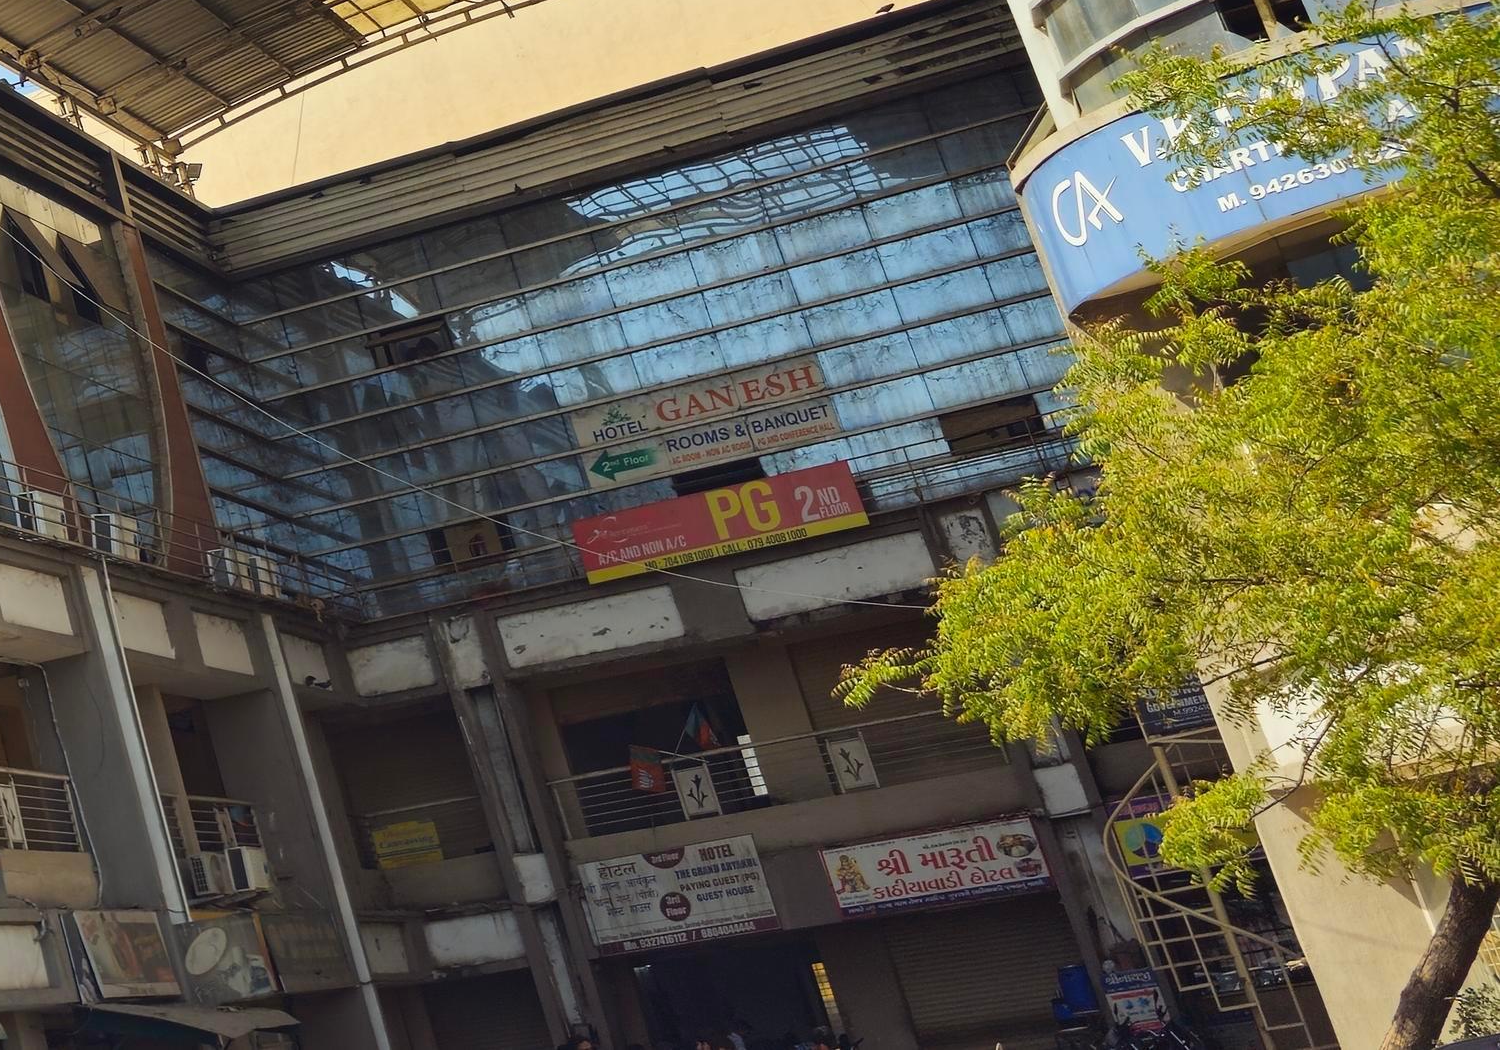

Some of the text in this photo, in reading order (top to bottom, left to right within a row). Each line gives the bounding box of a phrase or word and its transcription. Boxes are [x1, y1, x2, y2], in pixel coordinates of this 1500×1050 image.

[1217, 193, 1247, 213] M.
[655, 365, 819, 423] GANESH
[592, 420, 649, 443] HOTEL
[666, 404, 829, 452] ROOMS & BANQUET
[767, 434, 780, 445] AND
[780, 425, 818, 443] CONFERENCE
[818, 421, 835, 434] HALL
[624, 453, 649, 466] Floor
[684, 452, 703, 464] ROOM
[706, 447, 721, 460] NON
[722, 444, 732, 455] AC
[733, 440, 752, 454] ROOM
[704, 480, 783, 542] PG
[819, 501, 851, 519] FLOOR
[598, 535, 687, 566] A/C AND NON A/C
[663, 548, 714, 567] 7041081000
[721, 546, 741, 556] CALL
[747, 539, 764, 550] 079
[765, 527, 808, 547] 40081000
[697, 843, 735, 861] HOTEL
[877, 848, 912, 877] શ્રી
[674, 858, 759, 881] THE GRAND ARYAKUL
[679, 880, 711, 893] PAYING
[712, 875, 741, 888] GUEST
[696, 885, 755, 902] GUEST HOUSE
[872, 871, 965, 900] કાઠીયાવાડી
[970, 865, 1016, 885] હોટલ
[666, 894, 680, 905] 3rd
[665, 906, 687, 917] Floor
[641, 933, 689, 949] 9327416112
